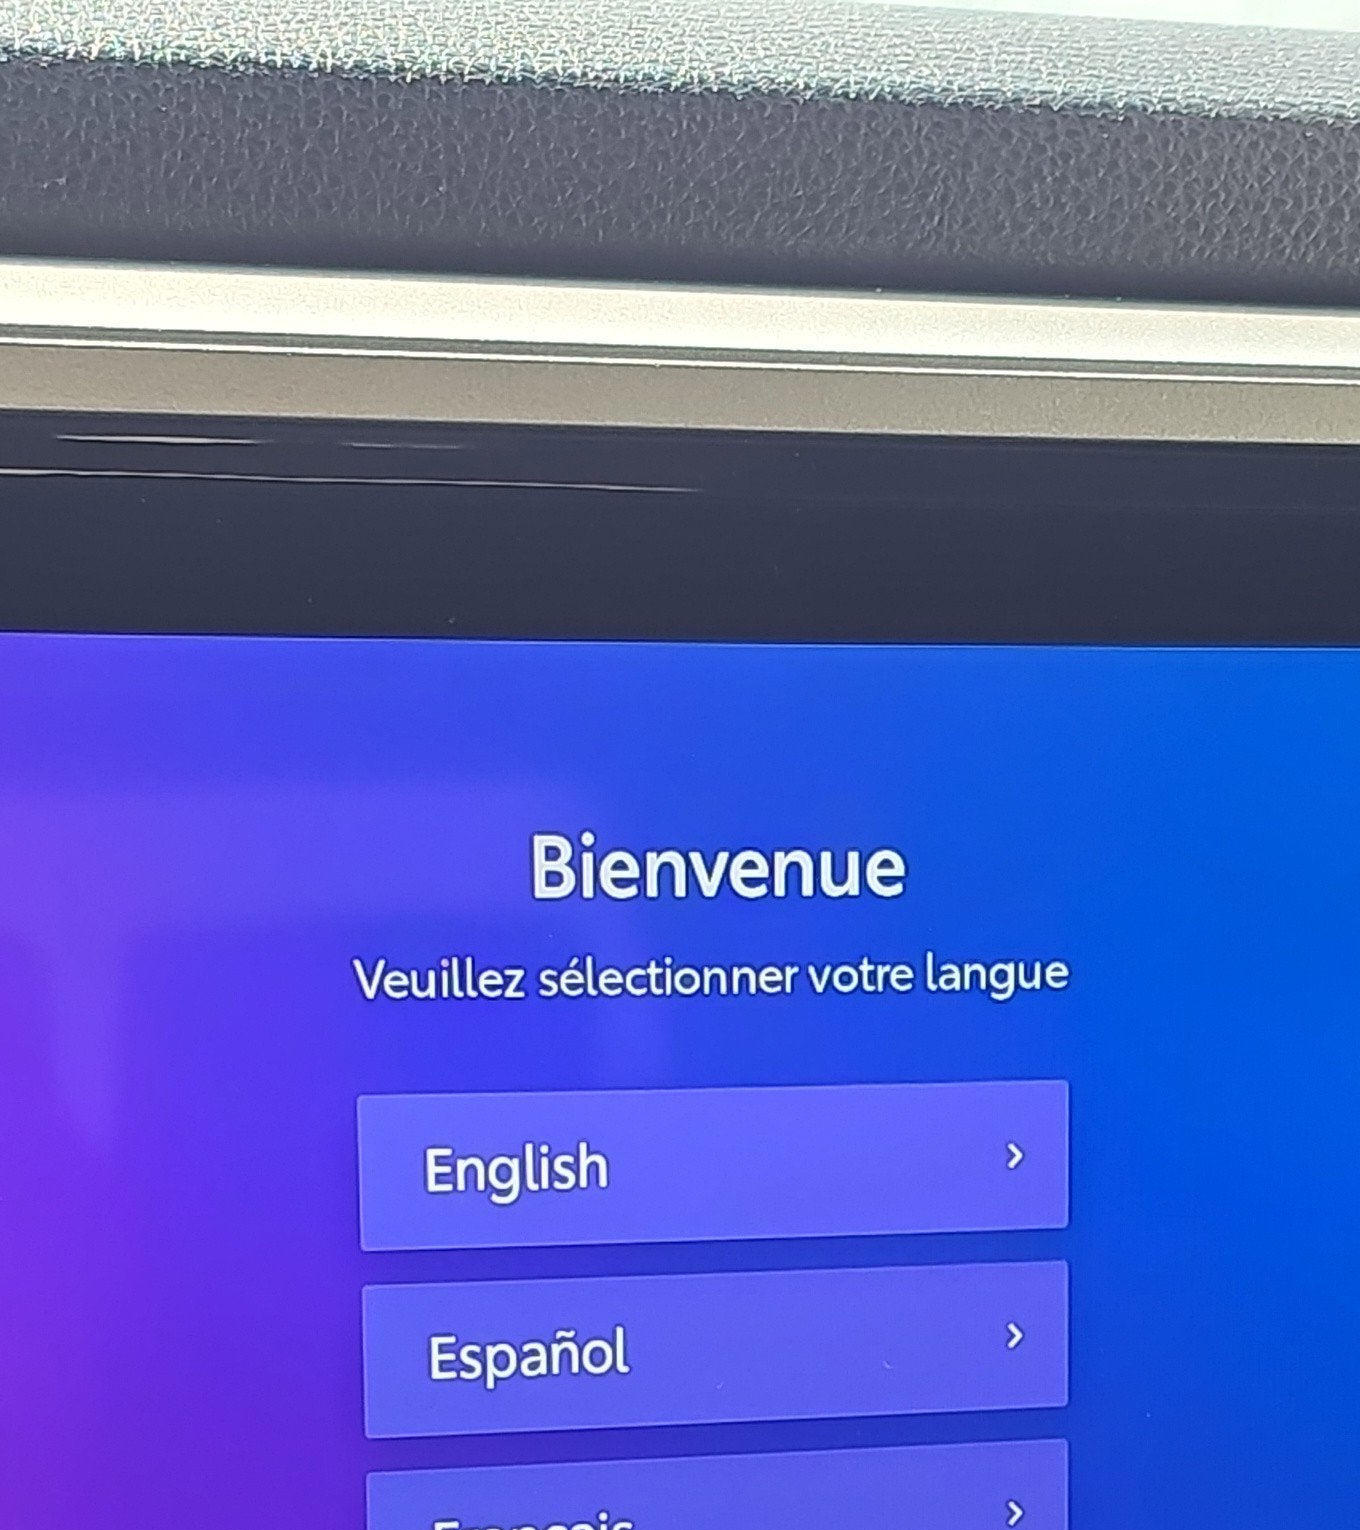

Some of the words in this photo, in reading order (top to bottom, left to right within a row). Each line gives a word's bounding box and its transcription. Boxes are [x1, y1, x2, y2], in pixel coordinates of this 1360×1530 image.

[530, 831, 907, 901] Bienvenue
[352, 957, 526, 1000] Veuillez
[538, 954, 800, 997] sélectionner
[807, 960, 915, 993] votre
[925, 952, 1070, 1000] langue
[424, 1142, 611, 1205] English
[428, 1326, 631, 1389] Español
